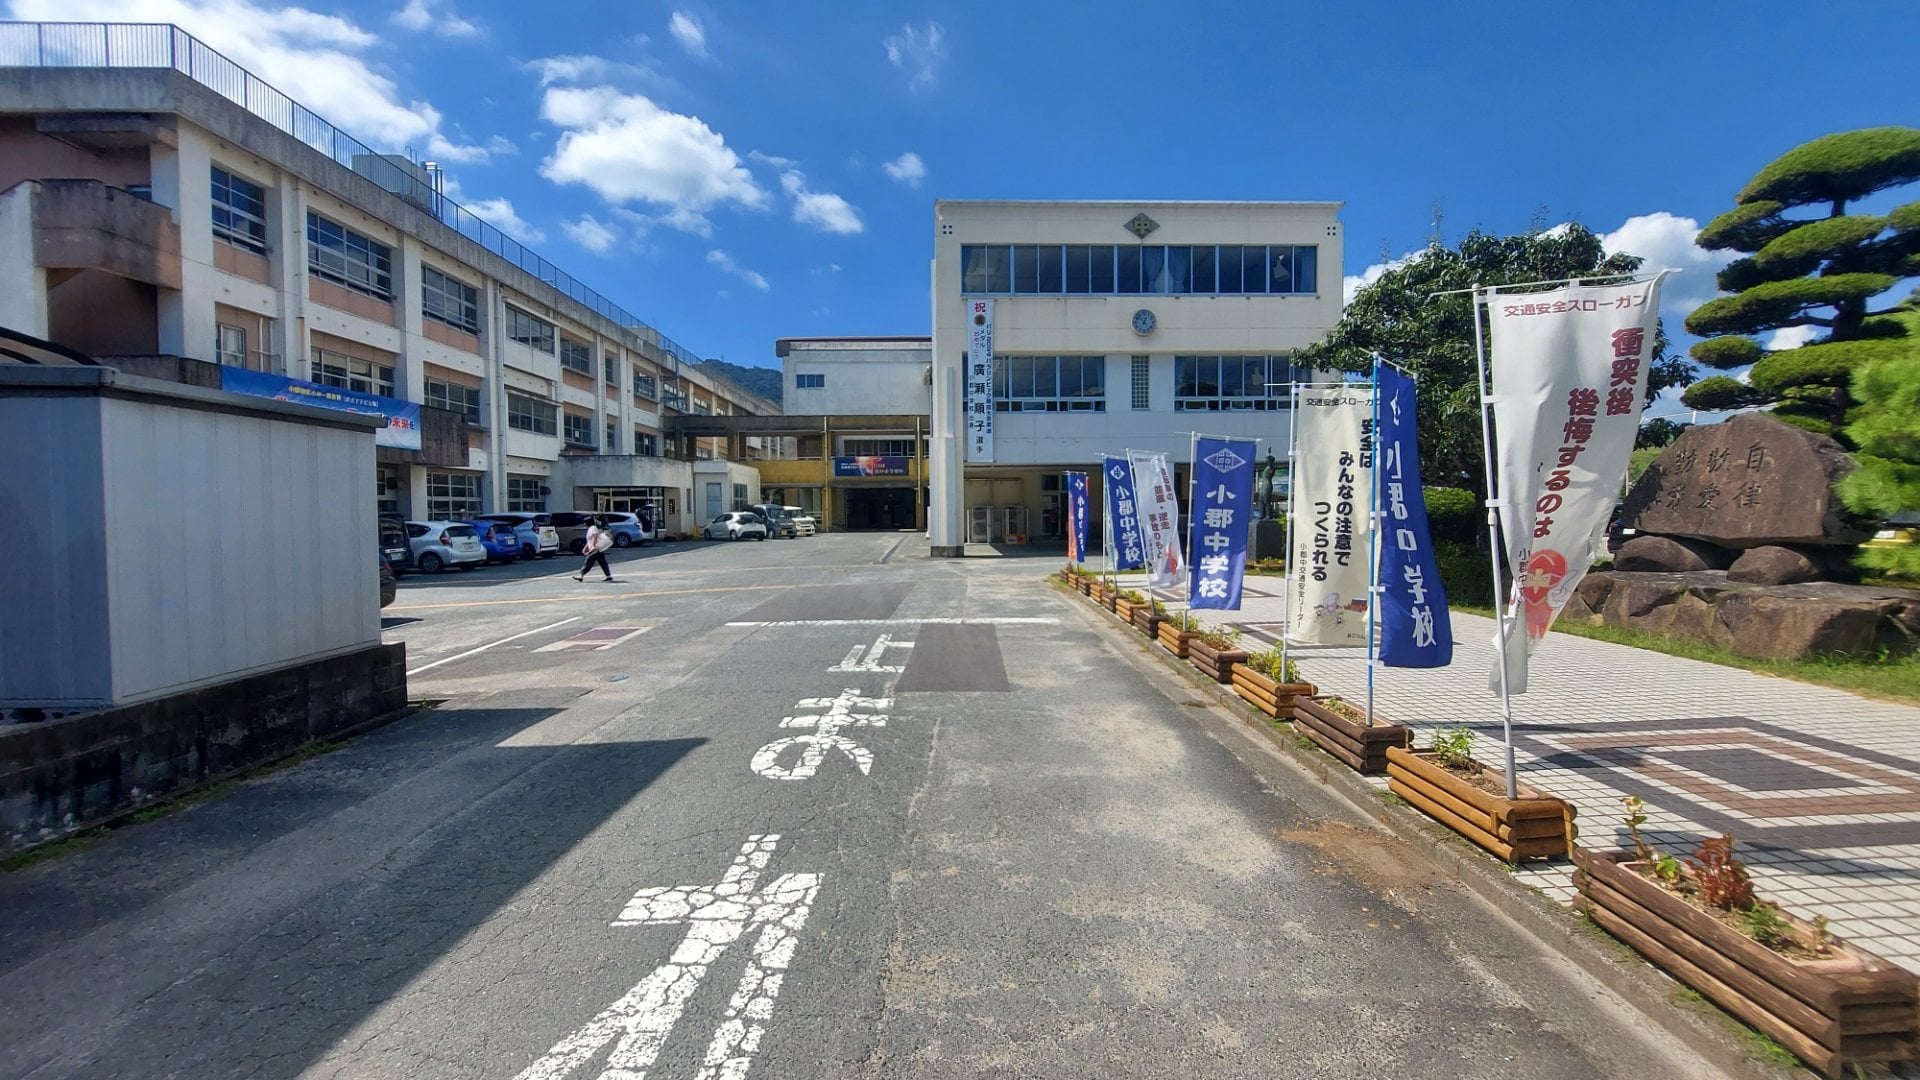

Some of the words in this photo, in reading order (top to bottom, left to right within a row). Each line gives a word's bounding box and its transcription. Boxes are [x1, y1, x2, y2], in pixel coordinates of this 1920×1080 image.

[974, 302, 986, 313] 祝
[1504, 295, 1647, 317] 交通安全スローガン
[1606, 326, 1645, 416] 衝突後
[1533, 387, 1600, 539] 後悔するのは
[1115, 484, 1142, 563] 小郡中学校
[1199, 484, 1236, 598] 小郡中学校
[1311, 501, 1332, 582] つくられる
[1335, 450, 1355, 567] みんなの注意で
